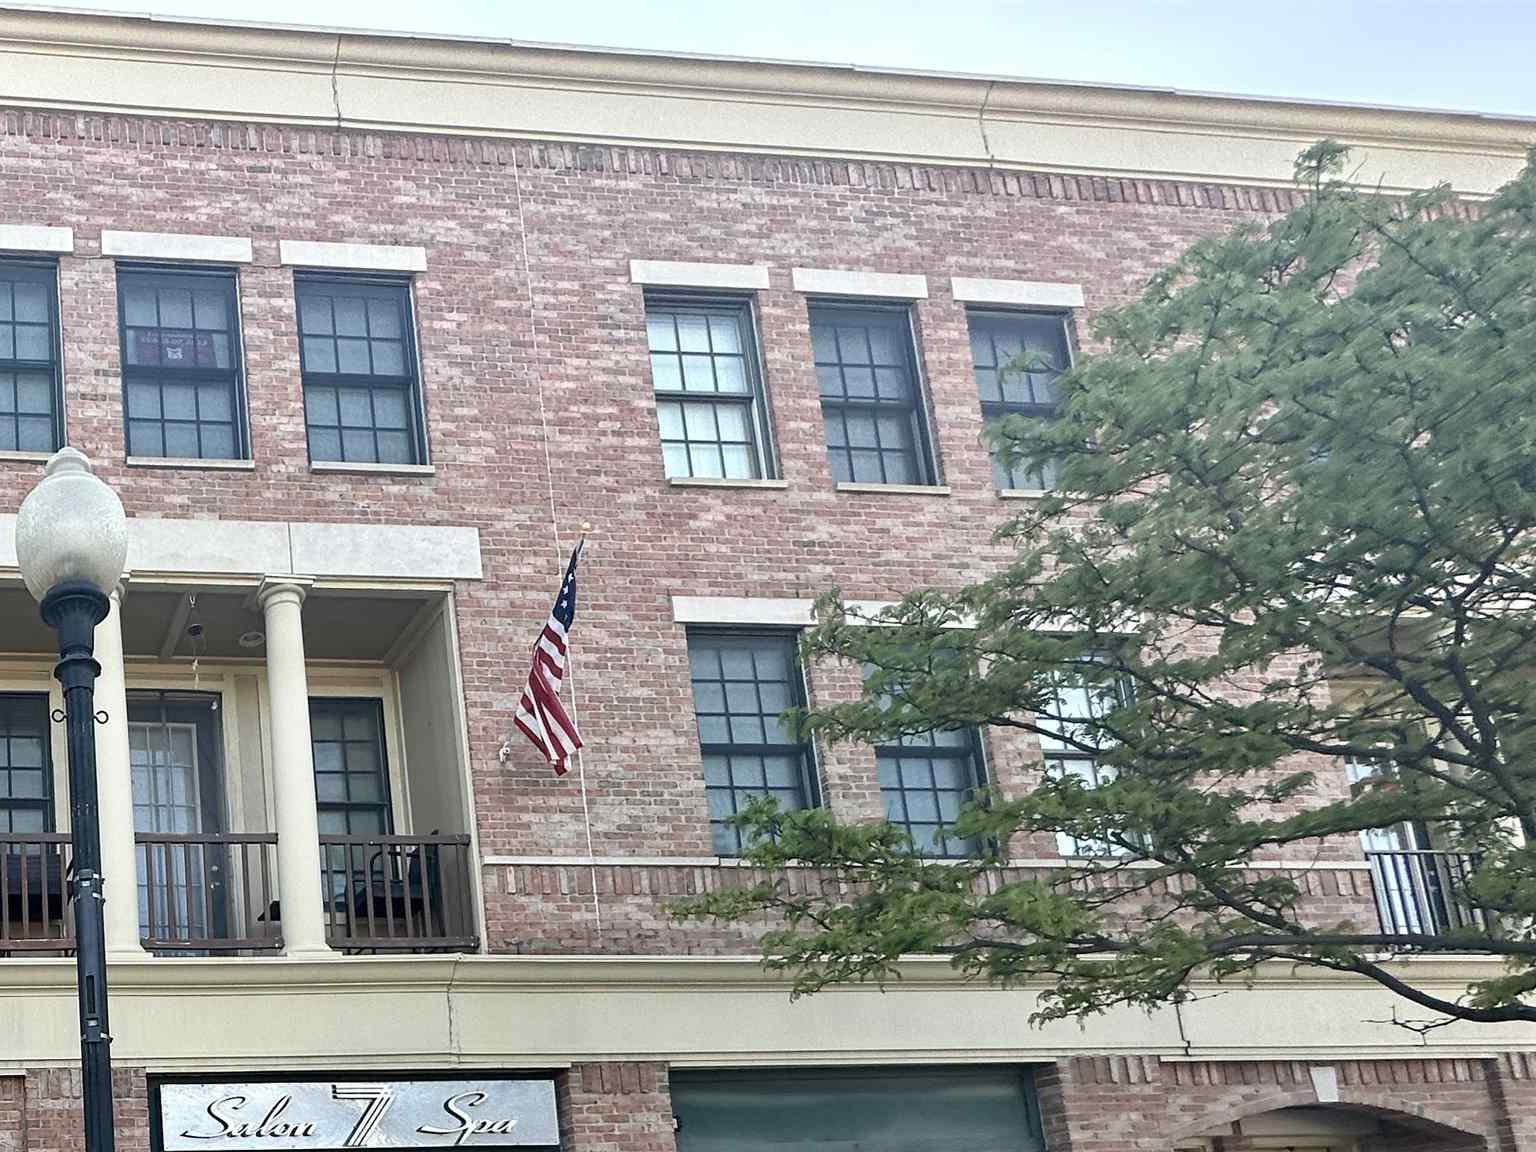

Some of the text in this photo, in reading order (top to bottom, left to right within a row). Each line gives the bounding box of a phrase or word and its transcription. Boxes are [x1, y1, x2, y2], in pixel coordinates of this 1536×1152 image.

[180, 1084, 519, 1147] Salon 7 Spa
